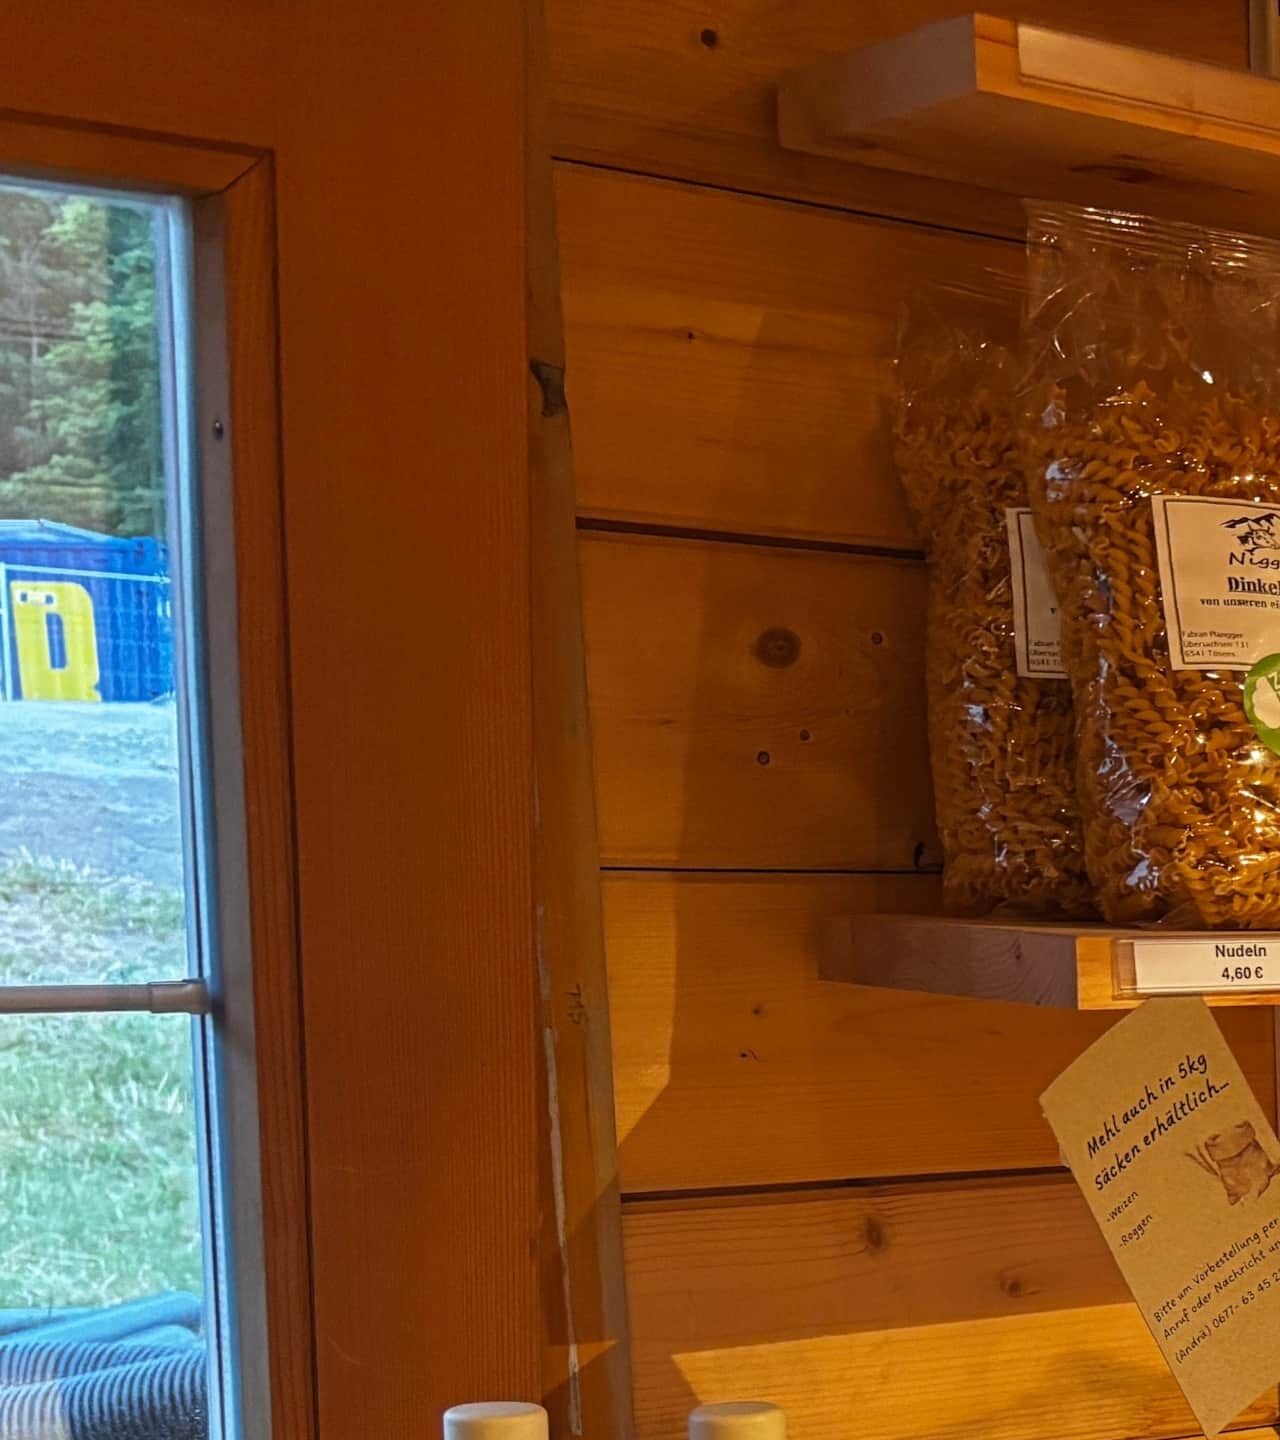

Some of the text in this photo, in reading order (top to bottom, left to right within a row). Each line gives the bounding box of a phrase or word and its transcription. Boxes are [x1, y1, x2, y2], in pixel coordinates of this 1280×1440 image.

[1224, 599, 1268, 608] unseren
[1216, 945, 1267, 958] Nudeln
[1222, 967, 1263, 982] 4,60 €
[1087, 1054, 1208, 1159] Mehl auch in 5kg
[1095, 1145, 1141, 1191] Säcken
[1120, 1215, 1153, 1248] -Roggen
[1154, 1218, 1280, 1323] Bitte um Vorbestellung per
[1164, 1309, 1190, 1340] Anruf
[1192, 1292, 1212, 1313] oder
[1215, 1250, 1266, 1294] Nachricht
[1213, 1304, 1240, 1329] 0677-
[1241, 1291, 1255, 1305] 63
[1257, 1279, 1271, 1293] 45
